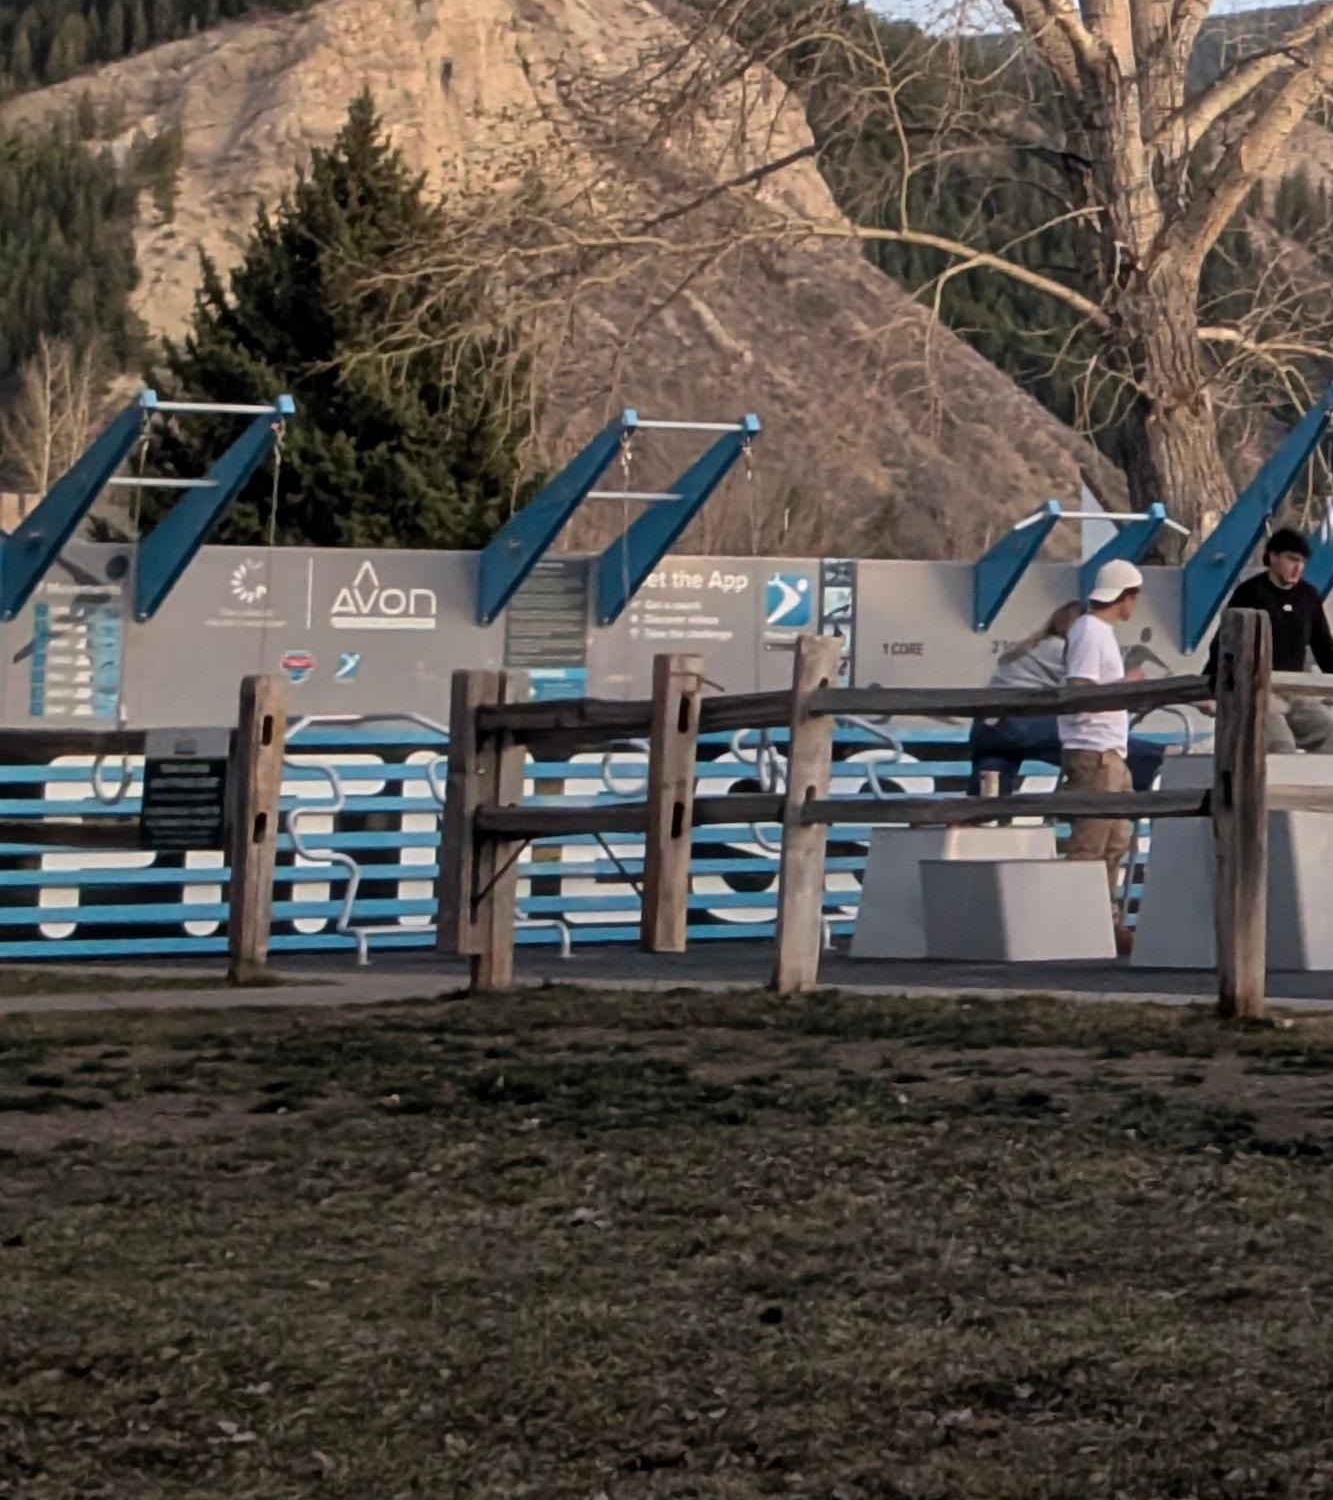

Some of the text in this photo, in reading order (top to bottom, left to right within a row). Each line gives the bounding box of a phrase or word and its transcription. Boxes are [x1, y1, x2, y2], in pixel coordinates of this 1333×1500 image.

[642, 570, 749, 593] et the App
[891, 642, 924, 656] CORE
